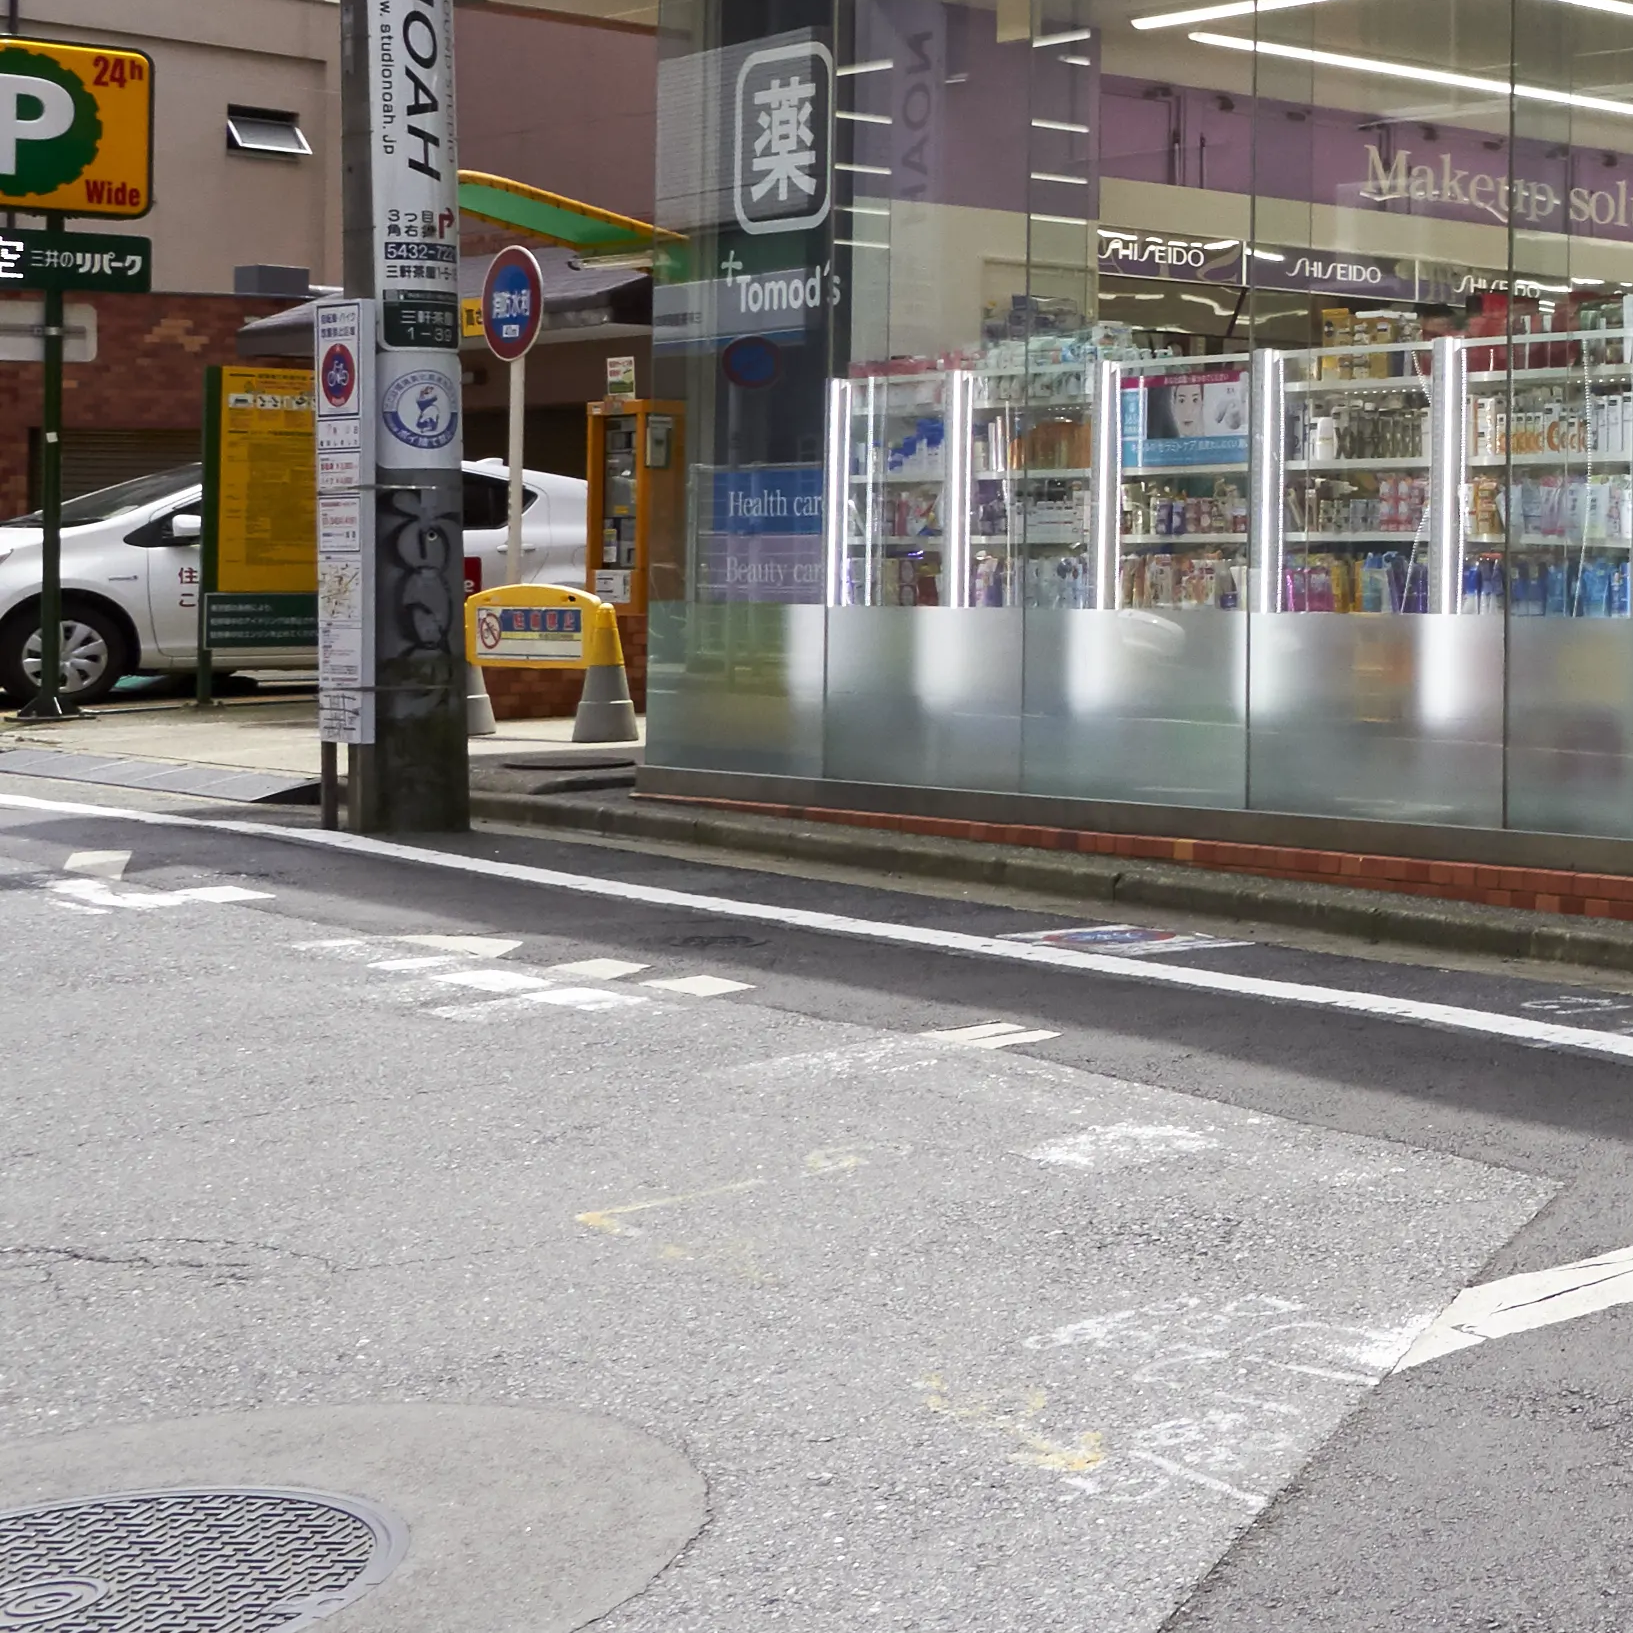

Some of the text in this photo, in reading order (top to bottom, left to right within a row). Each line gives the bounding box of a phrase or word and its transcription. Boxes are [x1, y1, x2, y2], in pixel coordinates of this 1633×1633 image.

[92, 55, 144, 88] 24h
[0, 73, 75, 175] P
[752, 79, 817, 202] 薬
[85, 180, 141, 207] Wide
[1363, 145, 1555, 222] Makeup
[30, 249, 143, 275] 三井のリパーク
[1098, 238, 1205, 267] SHISEIDO
[1286, 257, 1382, 283] SHISEIDO
[736, 259, 841, 313] Tomod's
[728, 489, 788, 517] Health
[726, 556, 787, 586] Beauty
